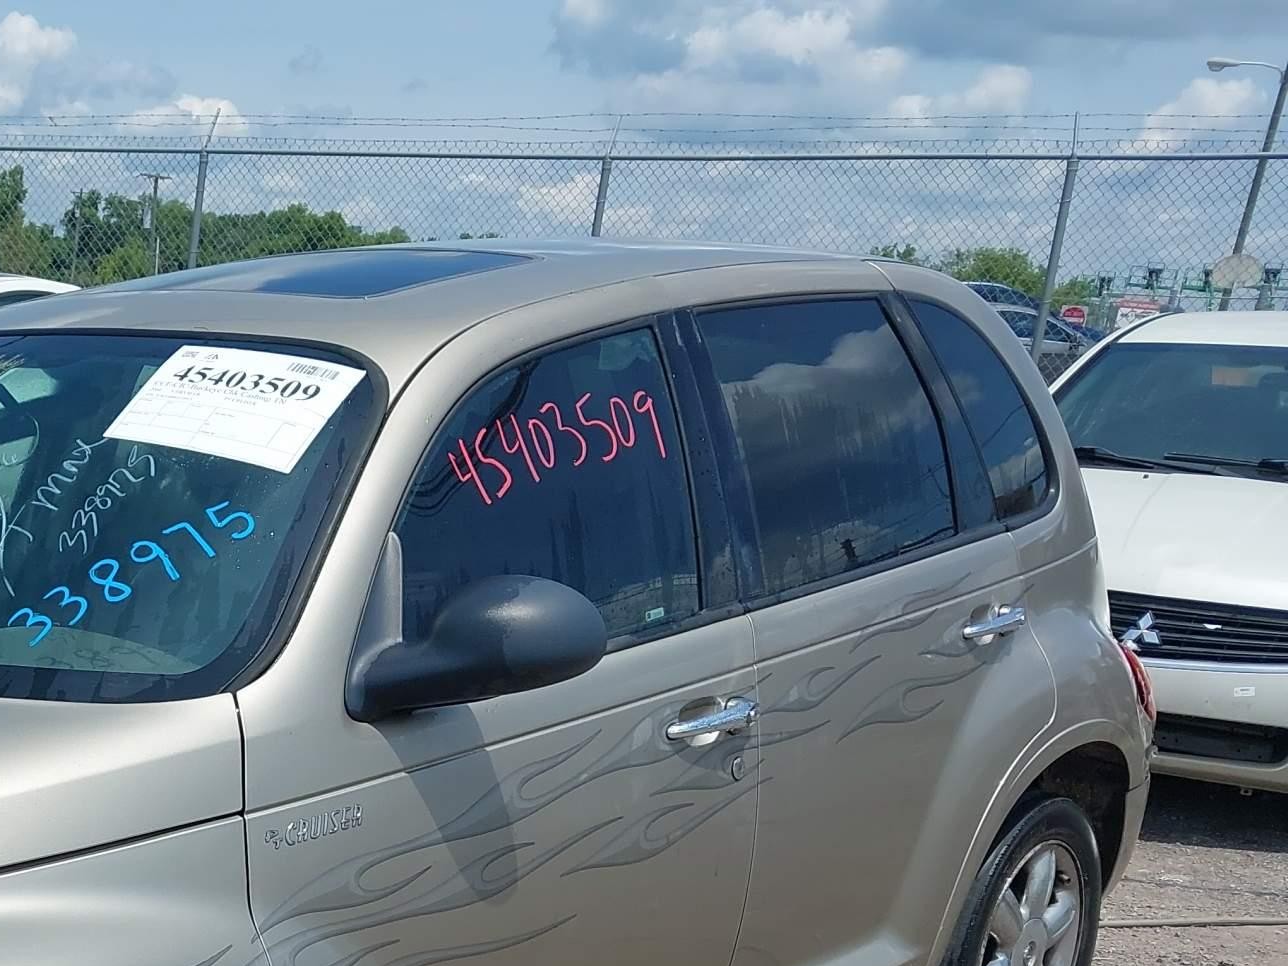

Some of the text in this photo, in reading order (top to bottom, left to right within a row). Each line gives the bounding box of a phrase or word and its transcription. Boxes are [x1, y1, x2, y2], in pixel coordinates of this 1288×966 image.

[173, 365, 321, 401] 45403509
[59, 444, 156, 555] 338975
[448, 390, 667, 504] 45403509
[7, 501, 256, 647] 338975
[285, 804, 364, 846] CRUISER
